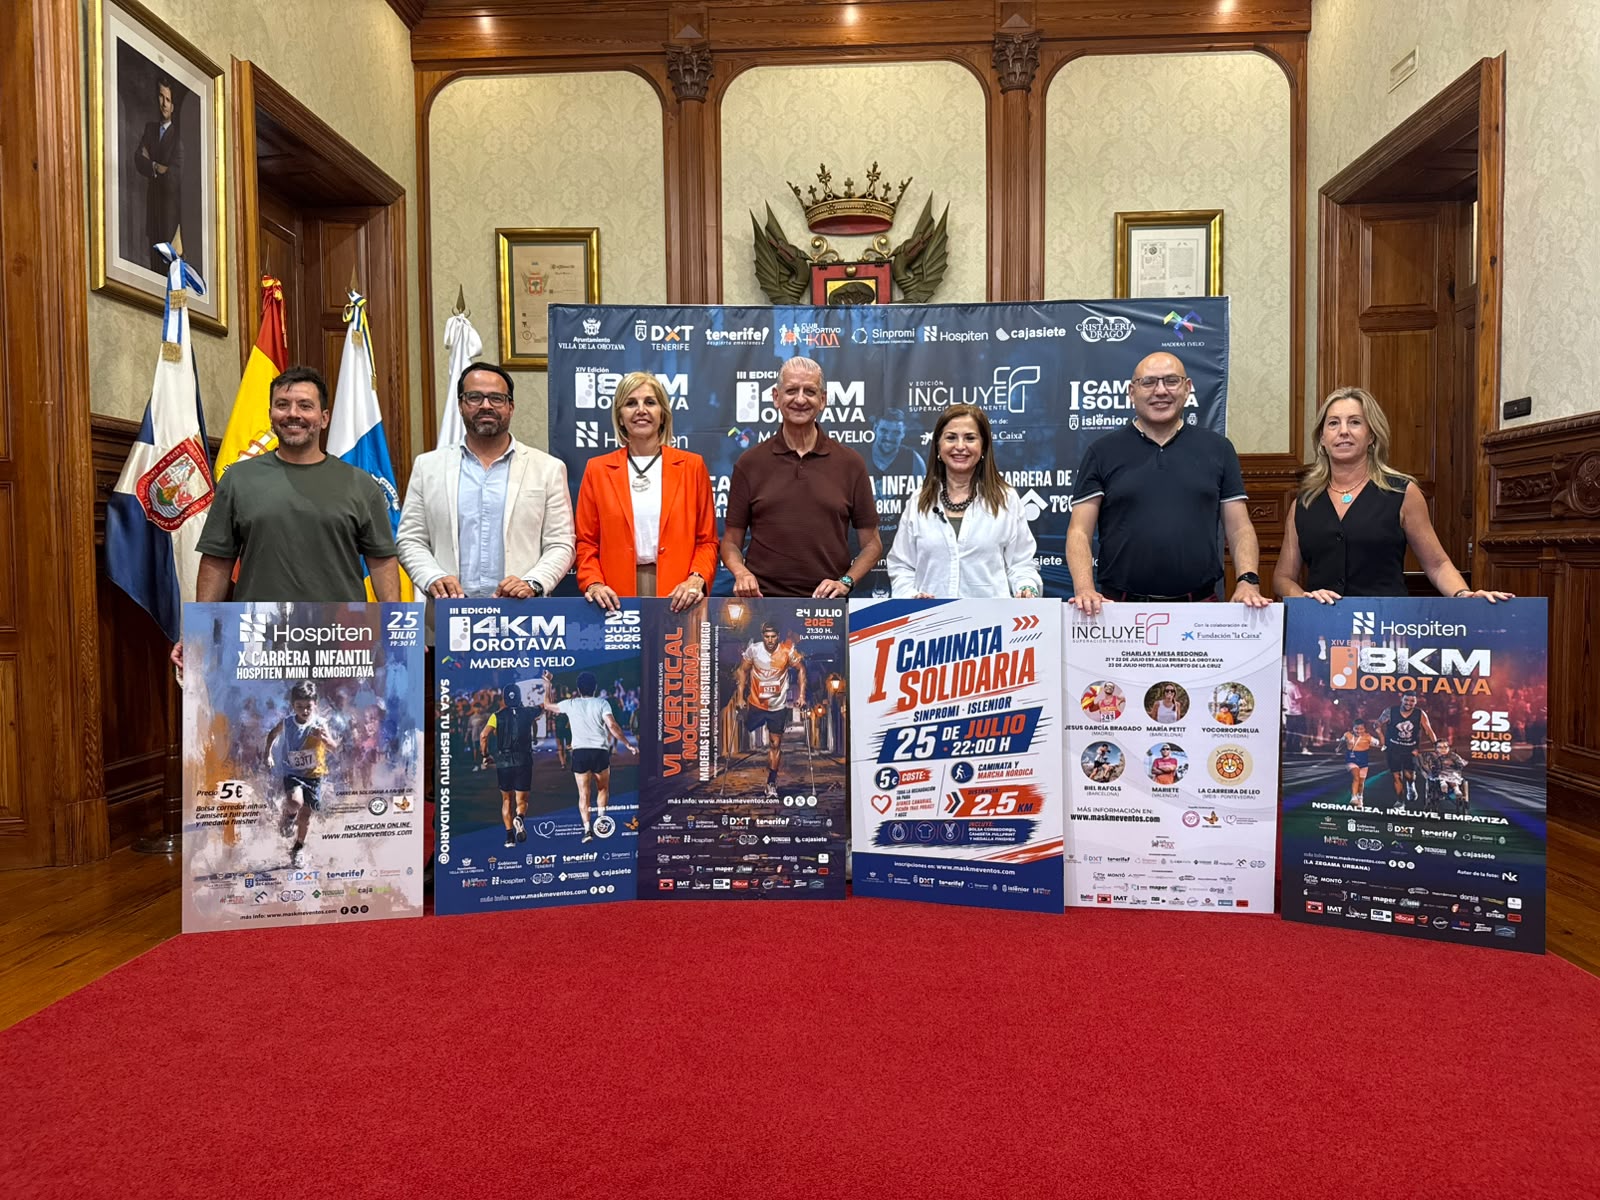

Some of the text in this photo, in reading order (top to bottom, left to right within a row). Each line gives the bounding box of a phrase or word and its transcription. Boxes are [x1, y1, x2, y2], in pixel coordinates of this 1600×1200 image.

[651, 325, 694, 341] DXT
[872, 328, 915, 338] Sinpromi
[940, 331, 988, 343] Hospiten
[1010, 326, 1066, 341] cajasiete
[652, 343, 690, 351] TENERIFE
[908, 386, 1007, 406] INCLUYE
[1069, 381, 1080, 410] I
[1056, 470, 1072, 486] DE
[461, 606, 500, 614] EDICIÓN
[796, 608, 842, 618] 24 JULIO
[388, 611, 419, 628] 25
[605, 610, 640, 625] 25
[804, 618, 834, 626] 2025
[472, 616, 566, 637] 4KM
[605, 626, 640, 634] JULIO
[1072, 626, 1145, 640] INCLUYE
[1381, 621, 1466, 638] Hospiten
[274, 624, 372, 645] Hospiten
[388, 631, 416, 640] JULIO
[604, 634, 641, 642] 2026
[701, 622, 711, 650] DRAGO
[472, 638, 566, 652] OROTAVA
[896, 625, 1002, 674] CAMINATA
[238, 650, 374, 666] X CARRERA INFANTIL
[470, 656, 575, 669] MADERAS EVELIO
[1360, 648, 1491, 676] 8KM
[236, 666, 374, 680] HOSPITEN MINI 8KMOROTAVA
[868, 636, 896, 704] I
[898, 647, 1035, 712] SOLIDARIA
[1360, 676, 1492, 696] OROTAVA
[663, 627, 683, 777] VI VERTICAL
[682, 643, 700, 760] NOCTURNA
[914, 696, 1012, 722] SINPROMI ISLENIOR
[1472, 710, 1510, 732] 25
[893, 714, 1026, 761] 25 DE JULIO
[1472, 732, 1512, 740] JULIO
[951, 737, 1011, 756] 22:00 H
[1470, 740, 1512, 752] 2026
[700, 739, 710, 782] MADERAS
[1471, 752, 1500, 760] 22:00
[438, 679, 452, 864] SACA TU ESPÍRITU SOLIDARIO@
[978, 762, 1012, 771] CAMINATA
[902, 772, 926, 782] COSTE:
[970, 792, 1034, 816] 2,5 KM
[1070, 814, 1160, 822] www.maskmeventos.com
[1312, 802, 1508, 825] NORMALIZA, INCLUYE, EMPATIZA
[230, 818, 257, 826] finisher
[730, 817, 750, 826] DXT
[322, 830, 412, 840] www.maskmeventos.com
[1394, 826, 1415, 834] DXT
[534, 855, 557, 864] DXT
[1462, 851, 1496, 860] cajasiete
[601, 868, 632, 876] cajasiete
[936, 864, 1016, 876] www.maskmeventos.com
[1342, 863, 1370, 872] URBANA)
[1372, 896, 1396, 904] maper
